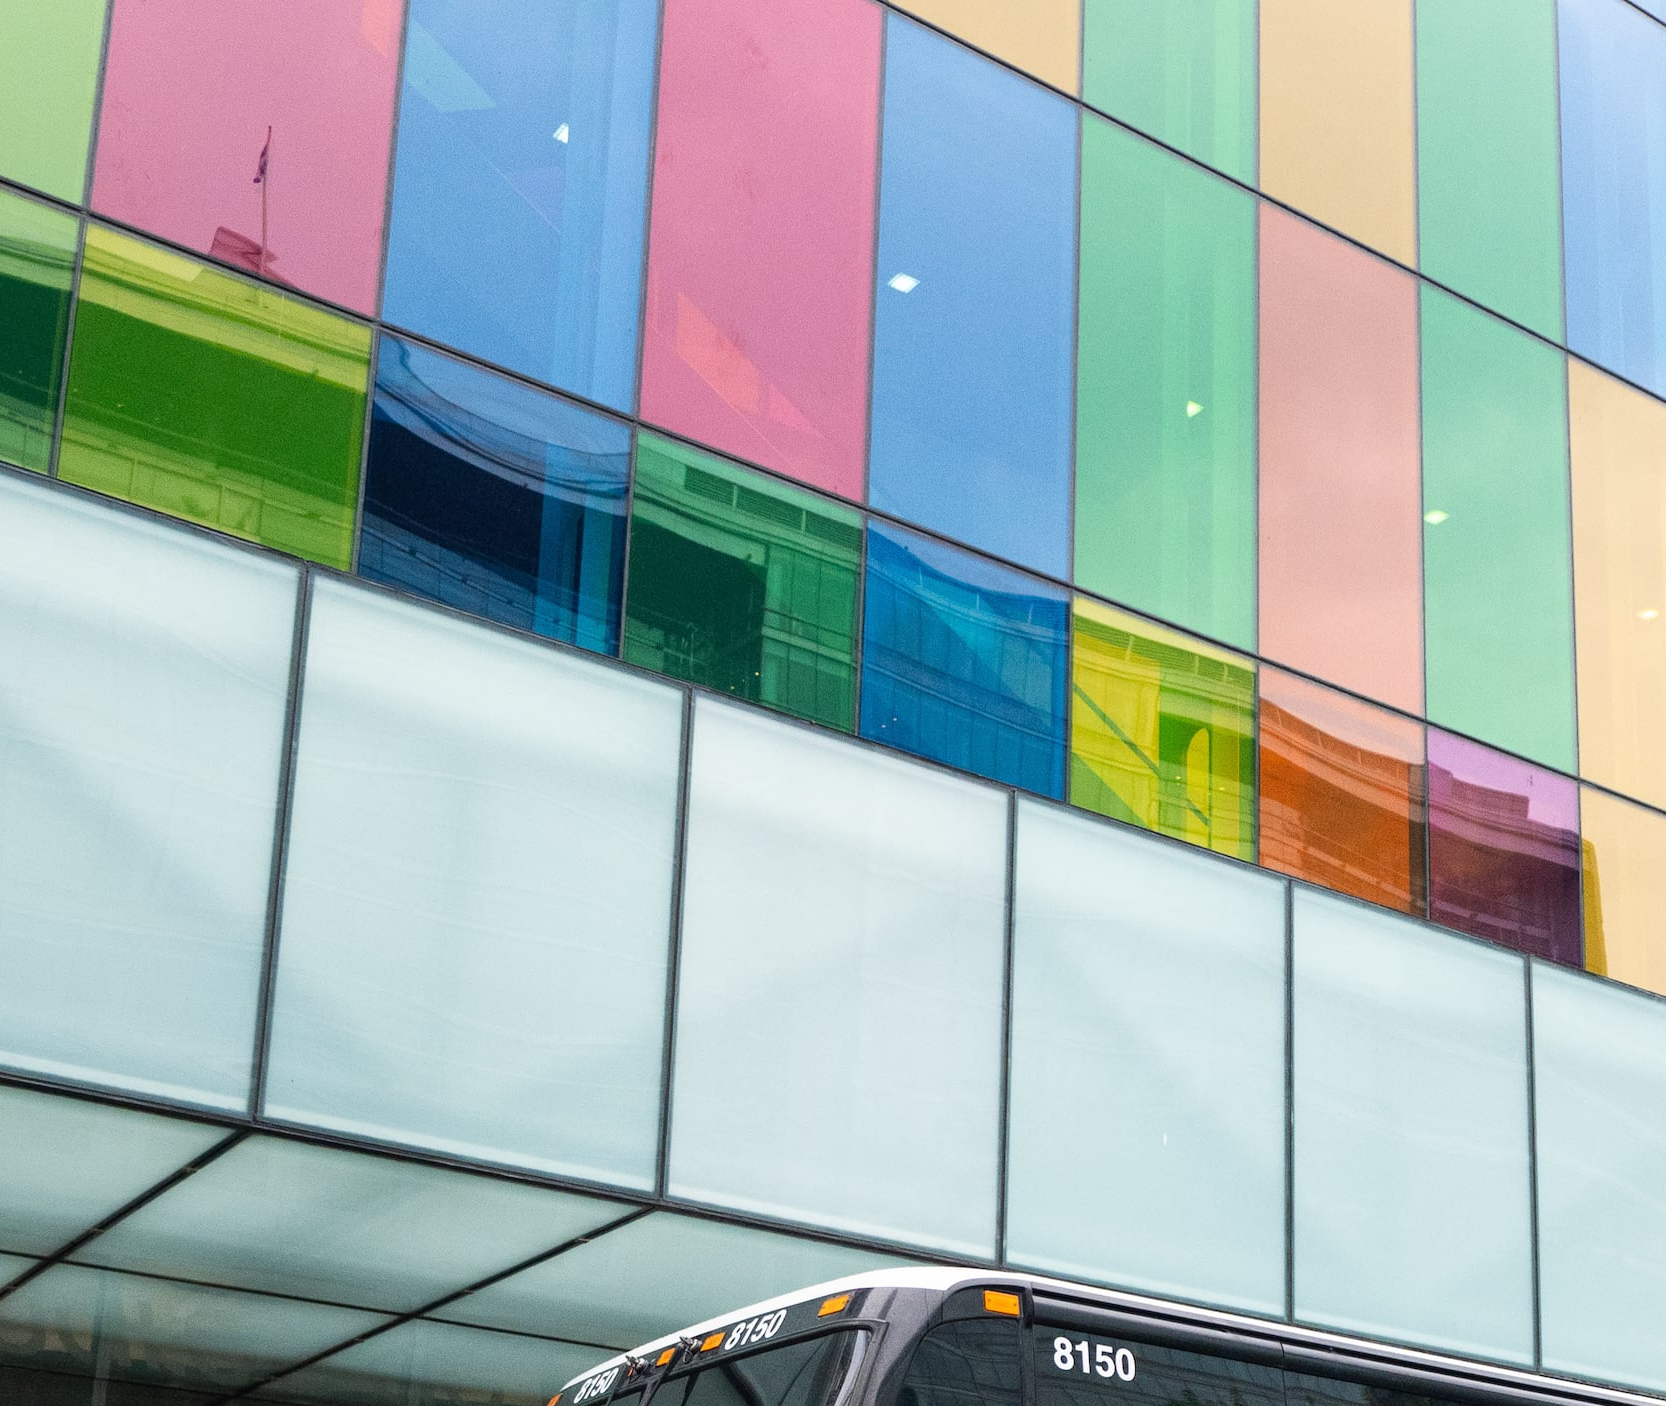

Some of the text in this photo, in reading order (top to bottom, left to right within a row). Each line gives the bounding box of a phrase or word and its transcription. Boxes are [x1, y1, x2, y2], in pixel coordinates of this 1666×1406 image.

[724, 1309, 787, 1351] 8150
[1053, 1336, 1136, 1382] 8150
[573, 1367, 620, 1404] 8150
